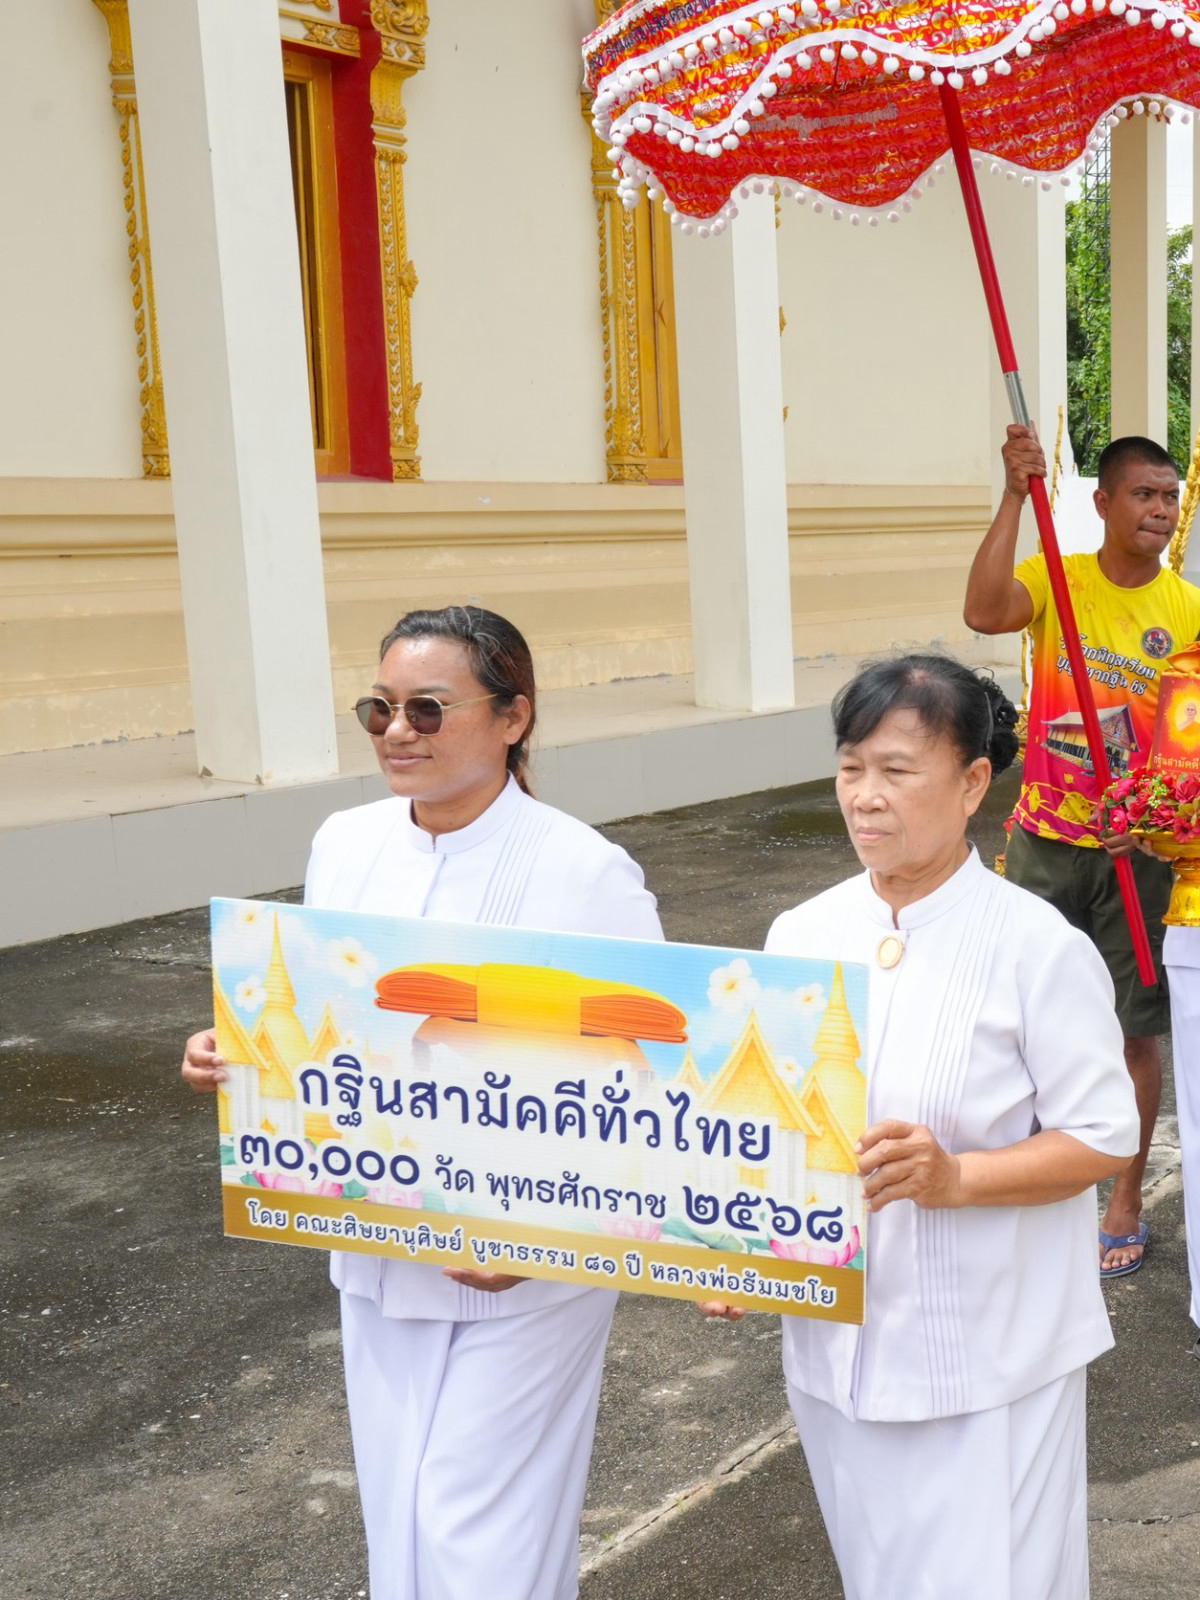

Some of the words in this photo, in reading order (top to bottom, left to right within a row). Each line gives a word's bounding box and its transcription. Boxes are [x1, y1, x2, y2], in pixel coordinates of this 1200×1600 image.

[1130, 679, 1147, 695] 68
[299, 1054, 771, 1162] กฐินสามัคคีทั่วไทย
[241, 1134, 420, 1186] ๓๐,๐๐๐
[435, 1155, 474, 1193] วัด
[486, 1170, 666, 1219] พุทธศักราช
[683, 1186, 844, 1244] ๒๕๖๘
[248, 1201, 287, 1228] โดย
[296, 1214, 461, 1253] คณะศิษยานุศิษย์
[472, 1238, 575, 1267] บูชาธรรม
[585, 1256, 616, 1275] ๘๑
[626, 1253, 641, 1277] ปี
[650, 1264, 835, 1306] หลวงพ่อธัมมชโย
